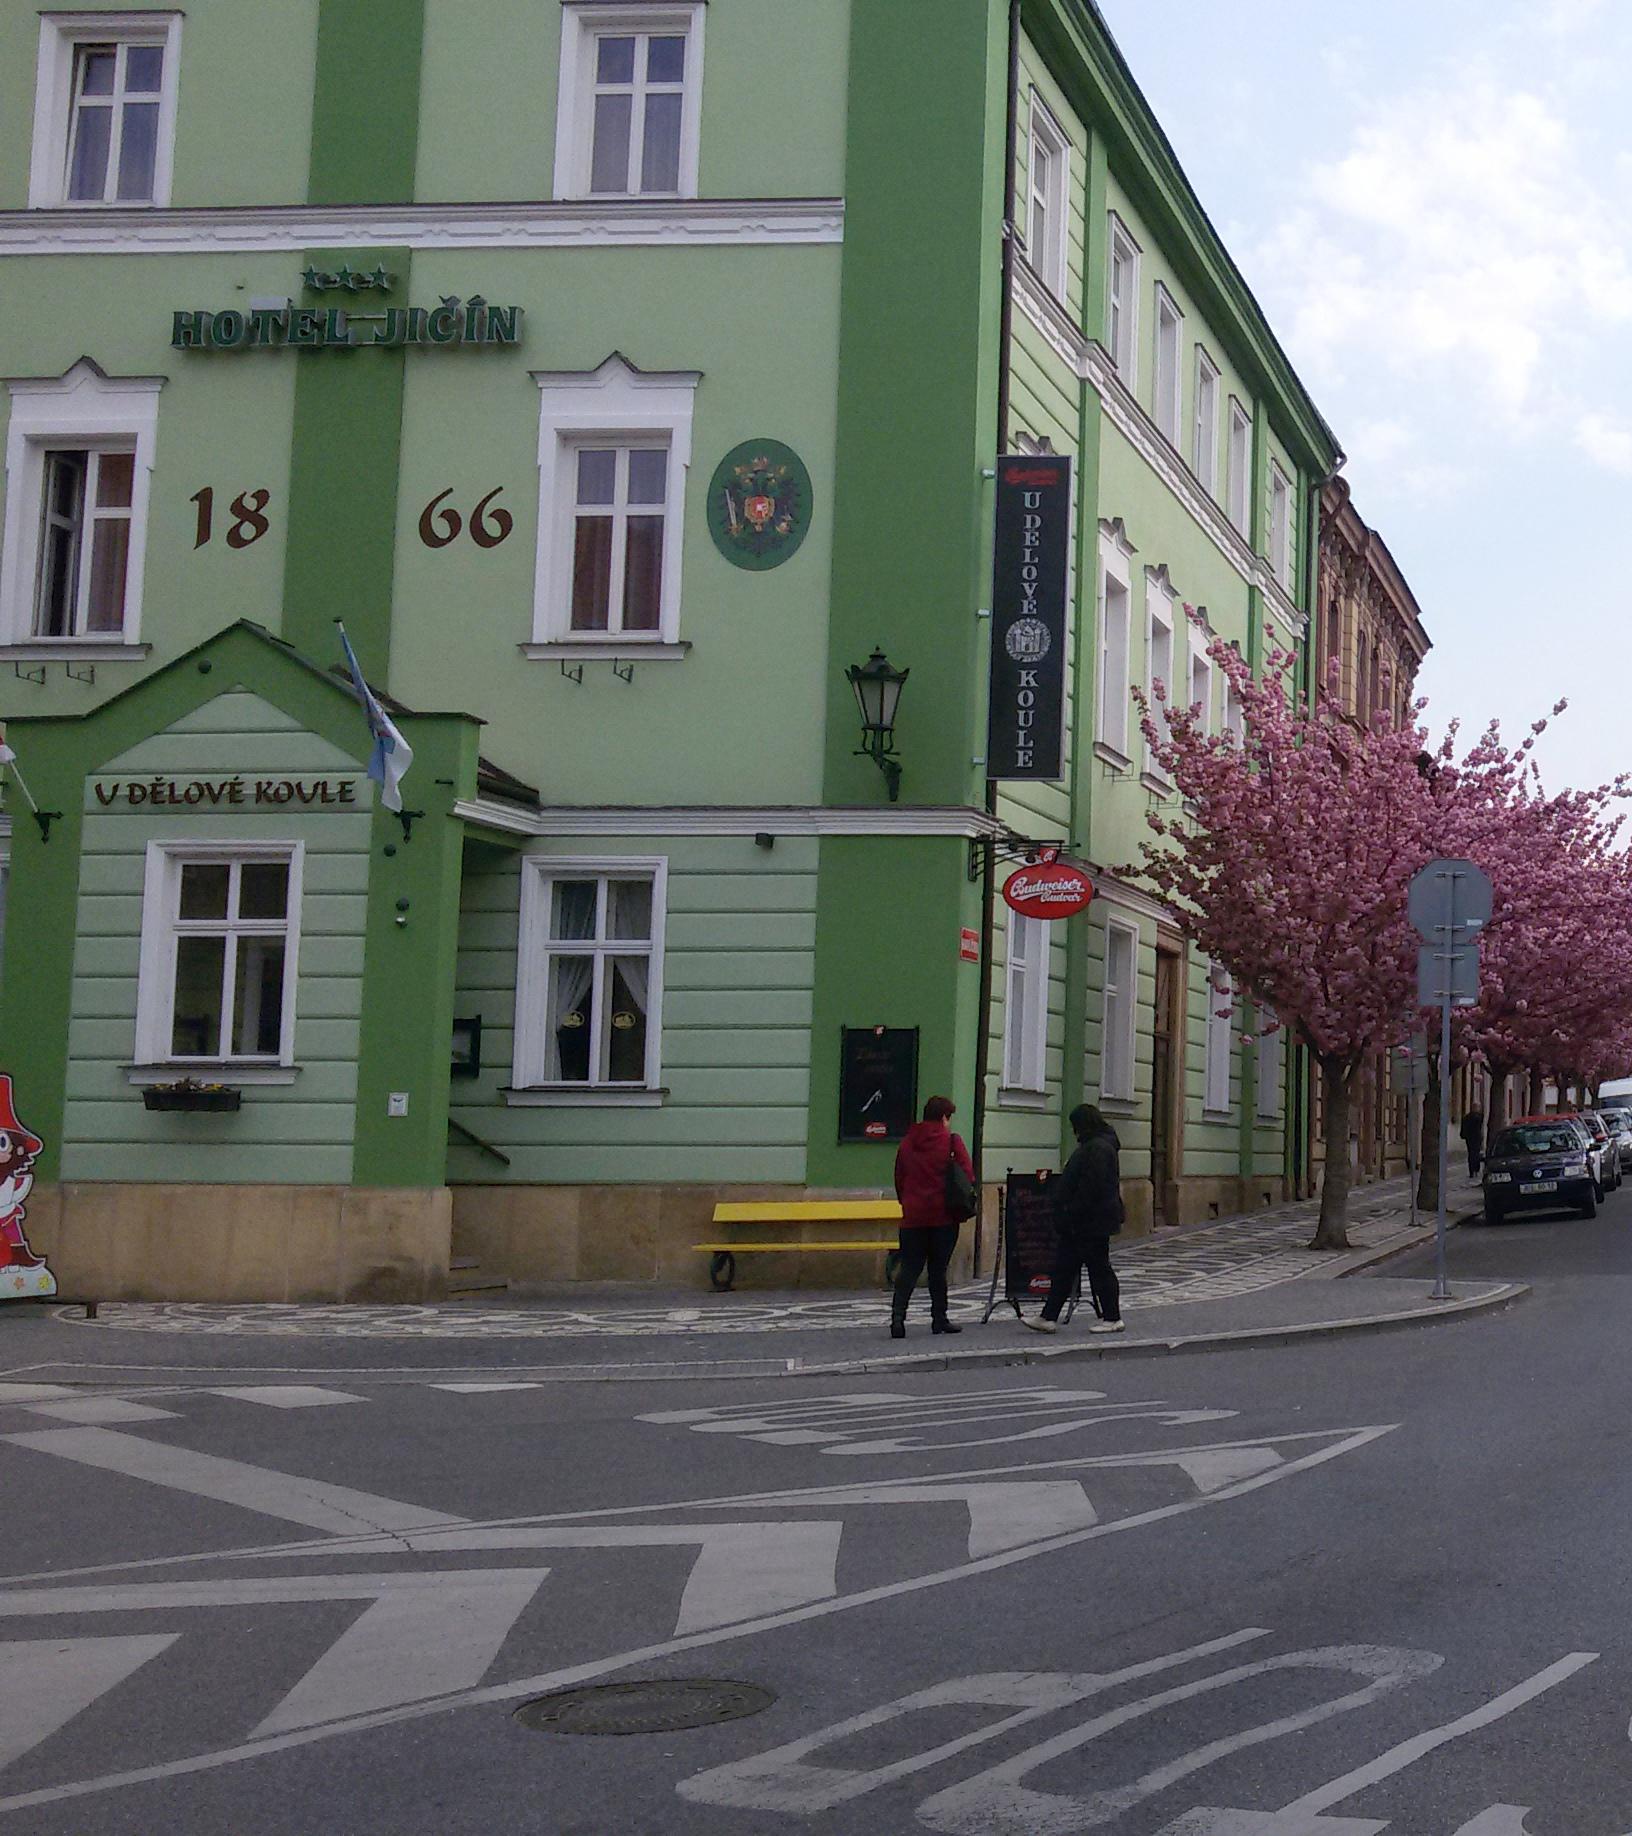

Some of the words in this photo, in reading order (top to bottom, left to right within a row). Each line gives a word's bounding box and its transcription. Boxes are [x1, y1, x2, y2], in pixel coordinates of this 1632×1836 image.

[170, 307, 352, 347] HOTEL
[372, 295, 524, 346] JIČÍN
[189, 486, 271, 550] 18
[418, 486, 514, 549] 66
[1022, 491, 1042, 510] U
[1015, 669, 1038, 769] KOULE
[126, 776, 246, 806] DĚLOVÉ
[254, 779, 356, 804] KOULE
[1010, 876, 1085, 900] Budweiser
[632, 1384, 1241, 1456] STOP
